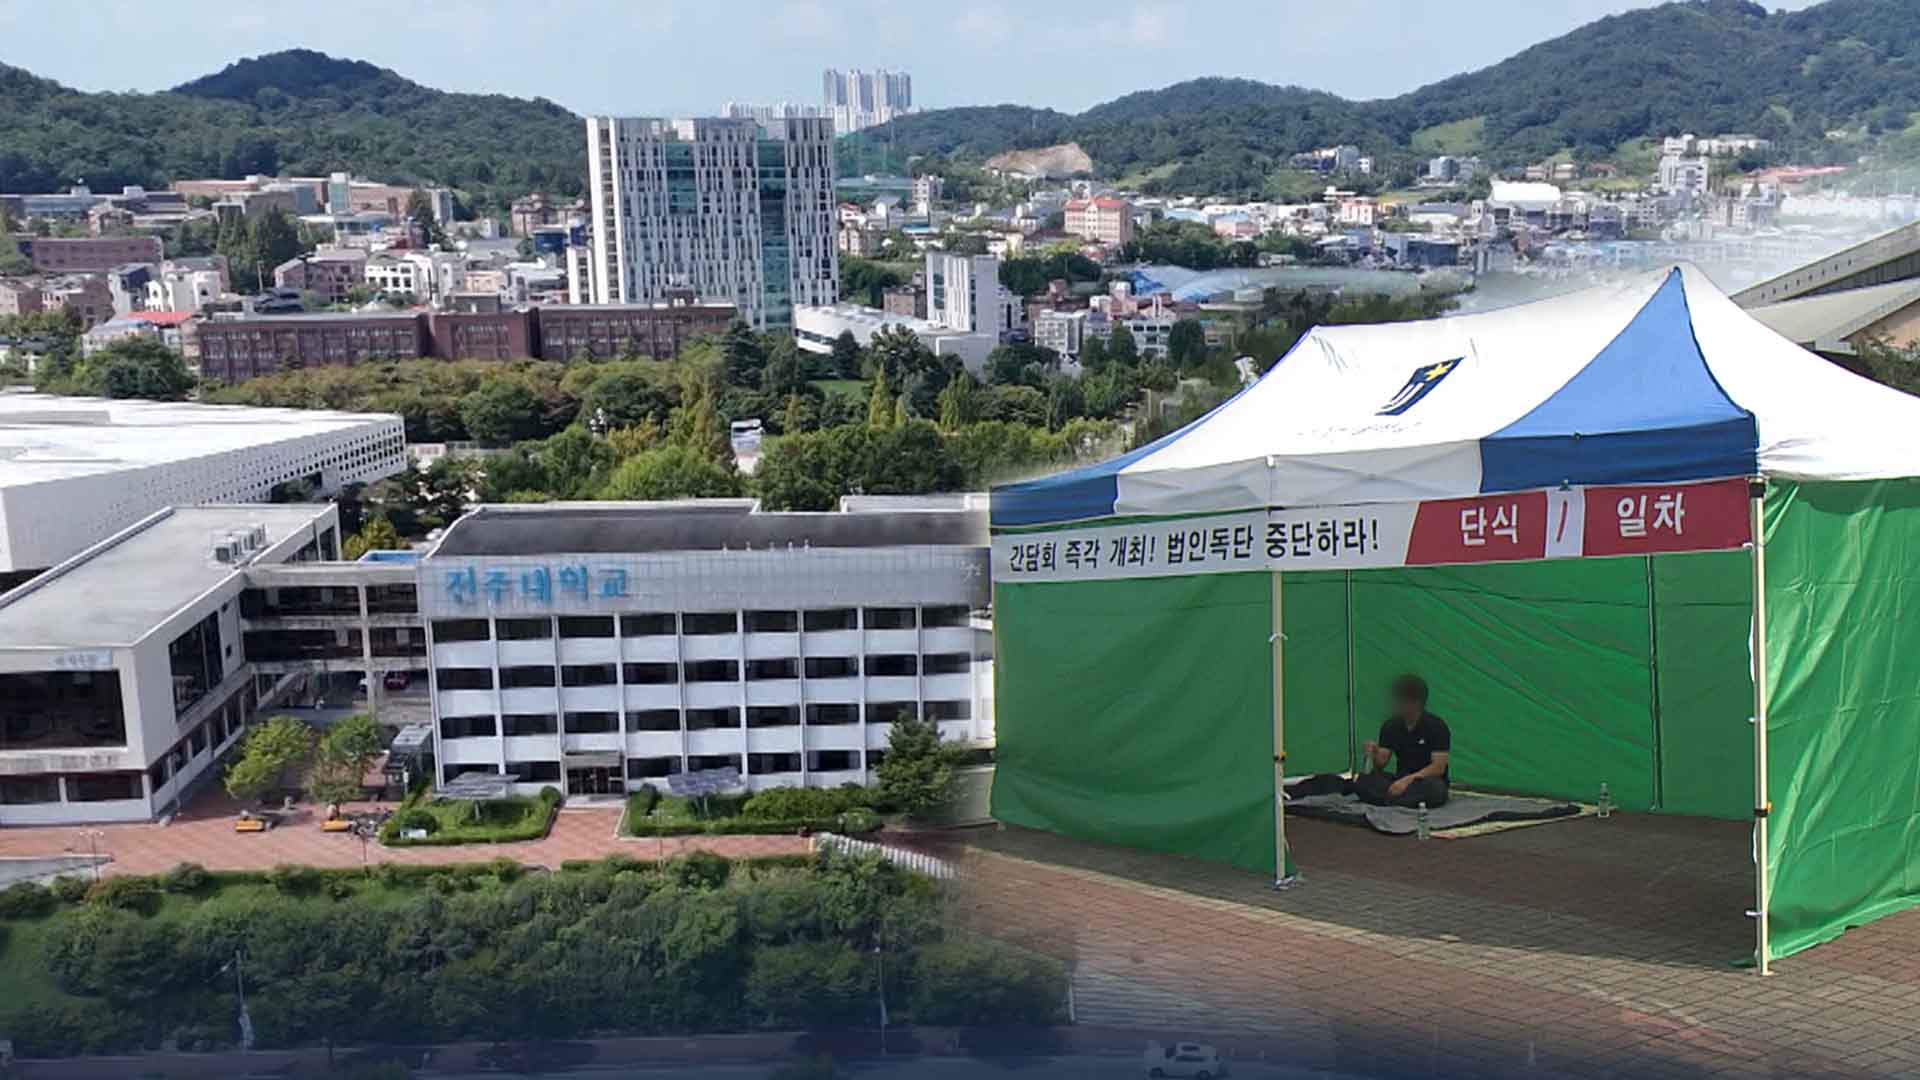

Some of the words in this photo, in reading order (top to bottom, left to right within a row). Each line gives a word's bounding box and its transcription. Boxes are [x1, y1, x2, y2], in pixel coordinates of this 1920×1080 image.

[1009, 542, 1057, 572] 간담회
[1064, 538, 1100, 569] 즉각
[1109, 534, 1156, 567] 개최!
[1167, 525, 1253, 564] 법인독단
[1265, 518, 1379, 559] 중단하라!
[1460, 503, 1519, 546] 단식
[1617, 492, 1685, 537] 일차
[446, 564, 634, 606] 전주대학교
